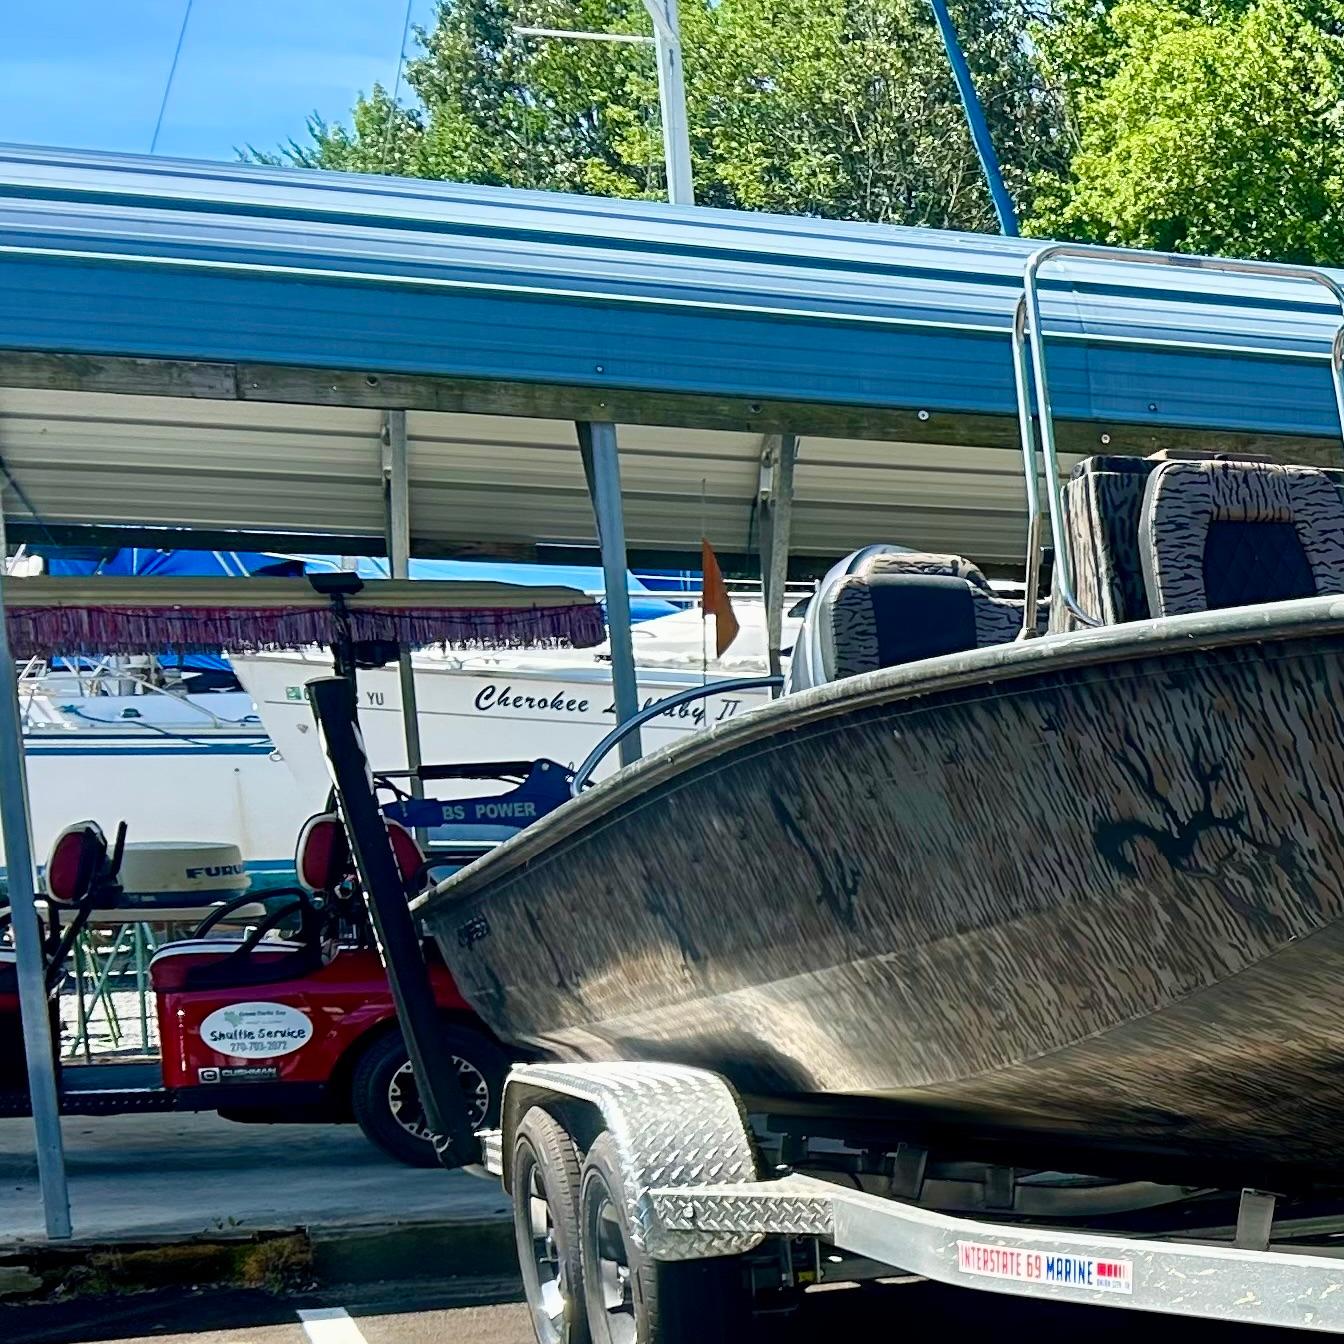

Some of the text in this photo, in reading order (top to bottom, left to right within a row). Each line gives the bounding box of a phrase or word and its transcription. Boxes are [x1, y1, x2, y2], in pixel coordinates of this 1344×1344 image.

[474, 685, 590, 712] Cherokee
[442, 802, 537, 820] BS POWER
[258, 1027, 306, 1040] Service
[961, 1243, 1093, 1286] INTERSTATE 69 MARINE
